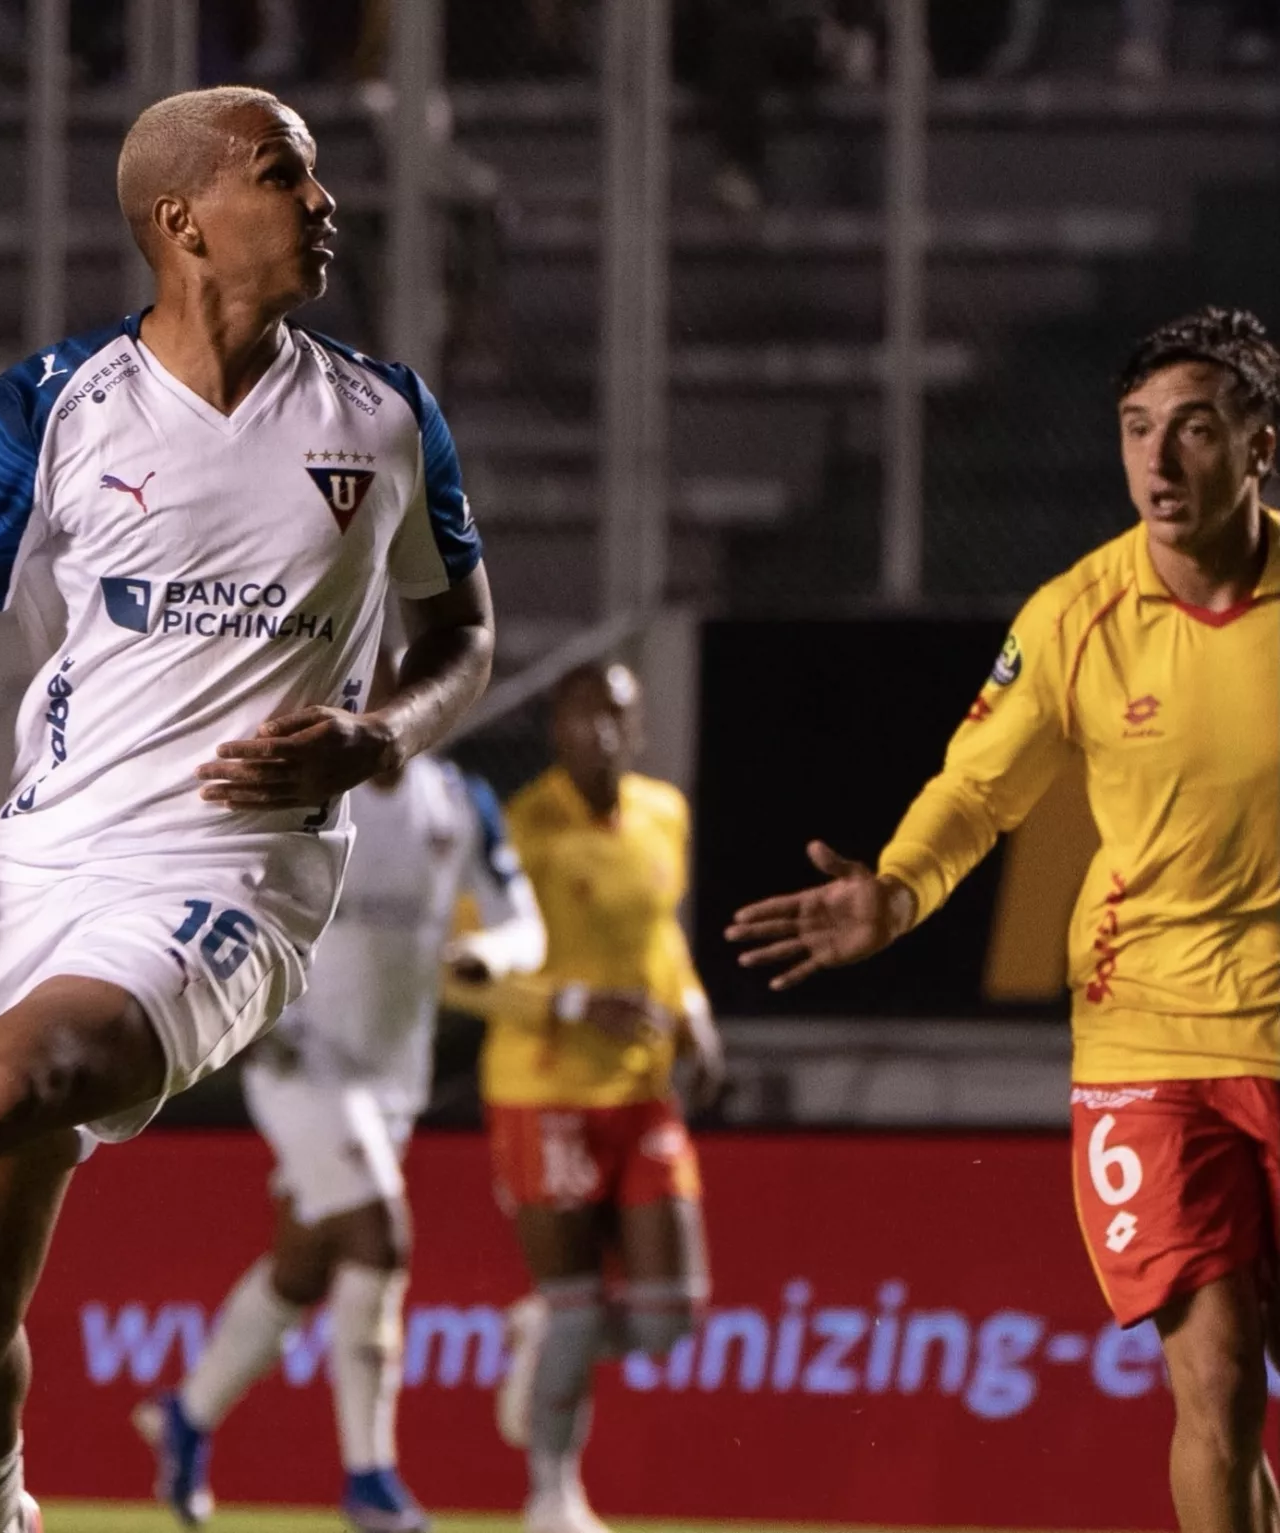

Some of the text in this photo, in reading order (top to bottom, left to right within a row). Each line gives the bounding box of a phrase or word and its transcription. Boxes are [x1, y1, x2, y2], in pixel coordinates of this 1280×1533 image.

[57, 352, 132, 421] DONGFENG
[329, 474, 356, 512] U
[165, 581, 287, 609] BANCO
[163, 610, 333, 643] PICHINCHA
[172, 899, 258, 980] 16
[1088, 1113, 1143, 1206] 6
